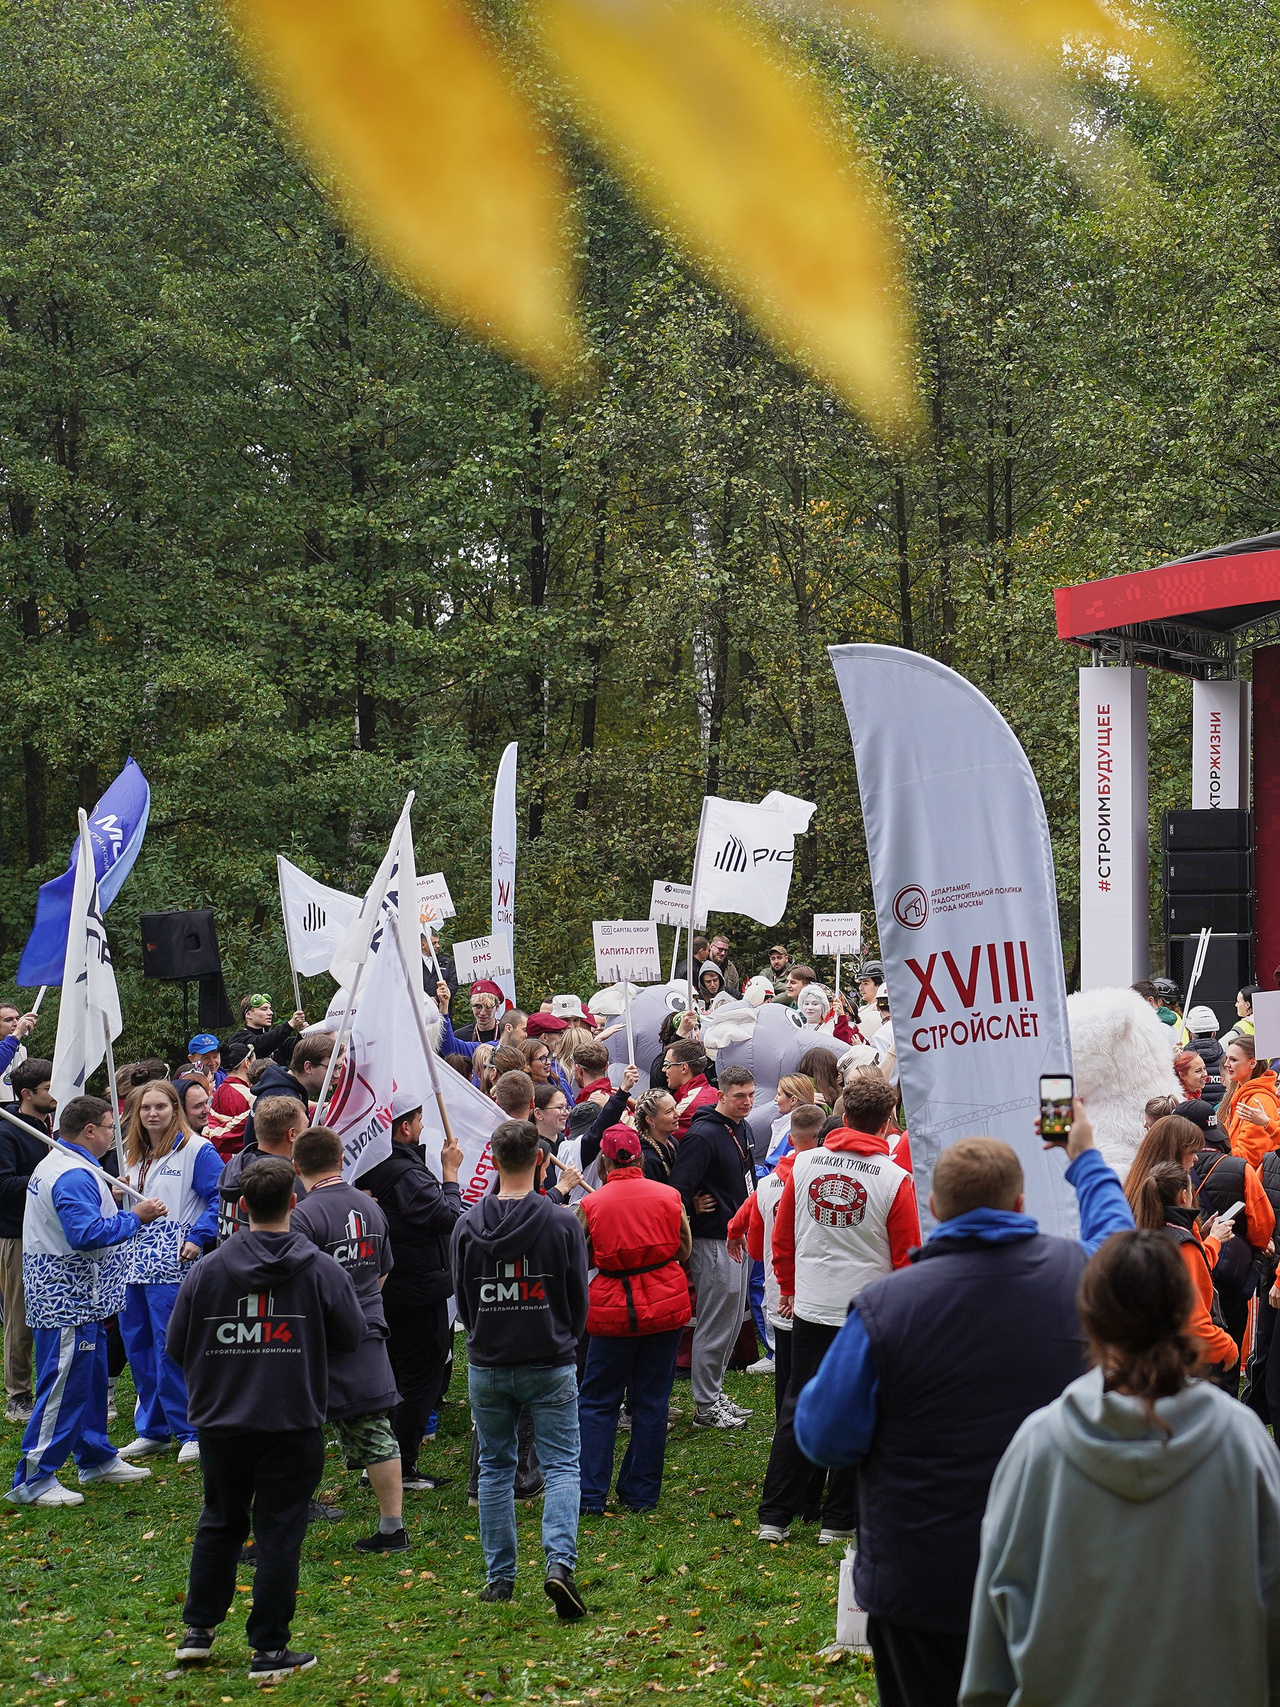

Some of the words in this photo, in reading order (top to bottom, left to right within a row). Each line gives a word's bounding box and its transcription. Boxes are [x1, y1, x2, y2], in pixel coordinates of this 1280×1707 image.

[1210, 712, 1221, 809] КТОРЖИЗНИ
[1097, 704, 1113, 892] #СТРОИМБУДУЩЕЕ
[418, 892, 447, 903] -ПРОЕКТ
[931, 883, 971, 897] ДЕПАРТАМЕНТ
[931, 888, 994, 905] ГРАДОСТРОИТЕЛЬНОЙ
[654, 899, 689, 909] МОСГОРГЕО
[932, 904, 957, 914] ГОРОДА
[958, 899, 984, 909] МОСКВЫ
[833, 928, 857, 938] СТРОЙ
[472, 953, 492, 964] BMS
[636, 947, 655, 955] ГРУП
[904, 940, 1034, 1019] XVIII
[911, 1007, 1039, 1052] СТРОЙСЛЁТ
[810, 1155, 845, 1168] НИКАКИХ
[846, 1159, 882, 1176] ТУПИКОВ
[480, 1281, 546, 1303] СМ14
[216, 1322, 292, 1344] СМ14
[205, 1348, 260, 1356] СТРОИТЕЛЬНАЯ
